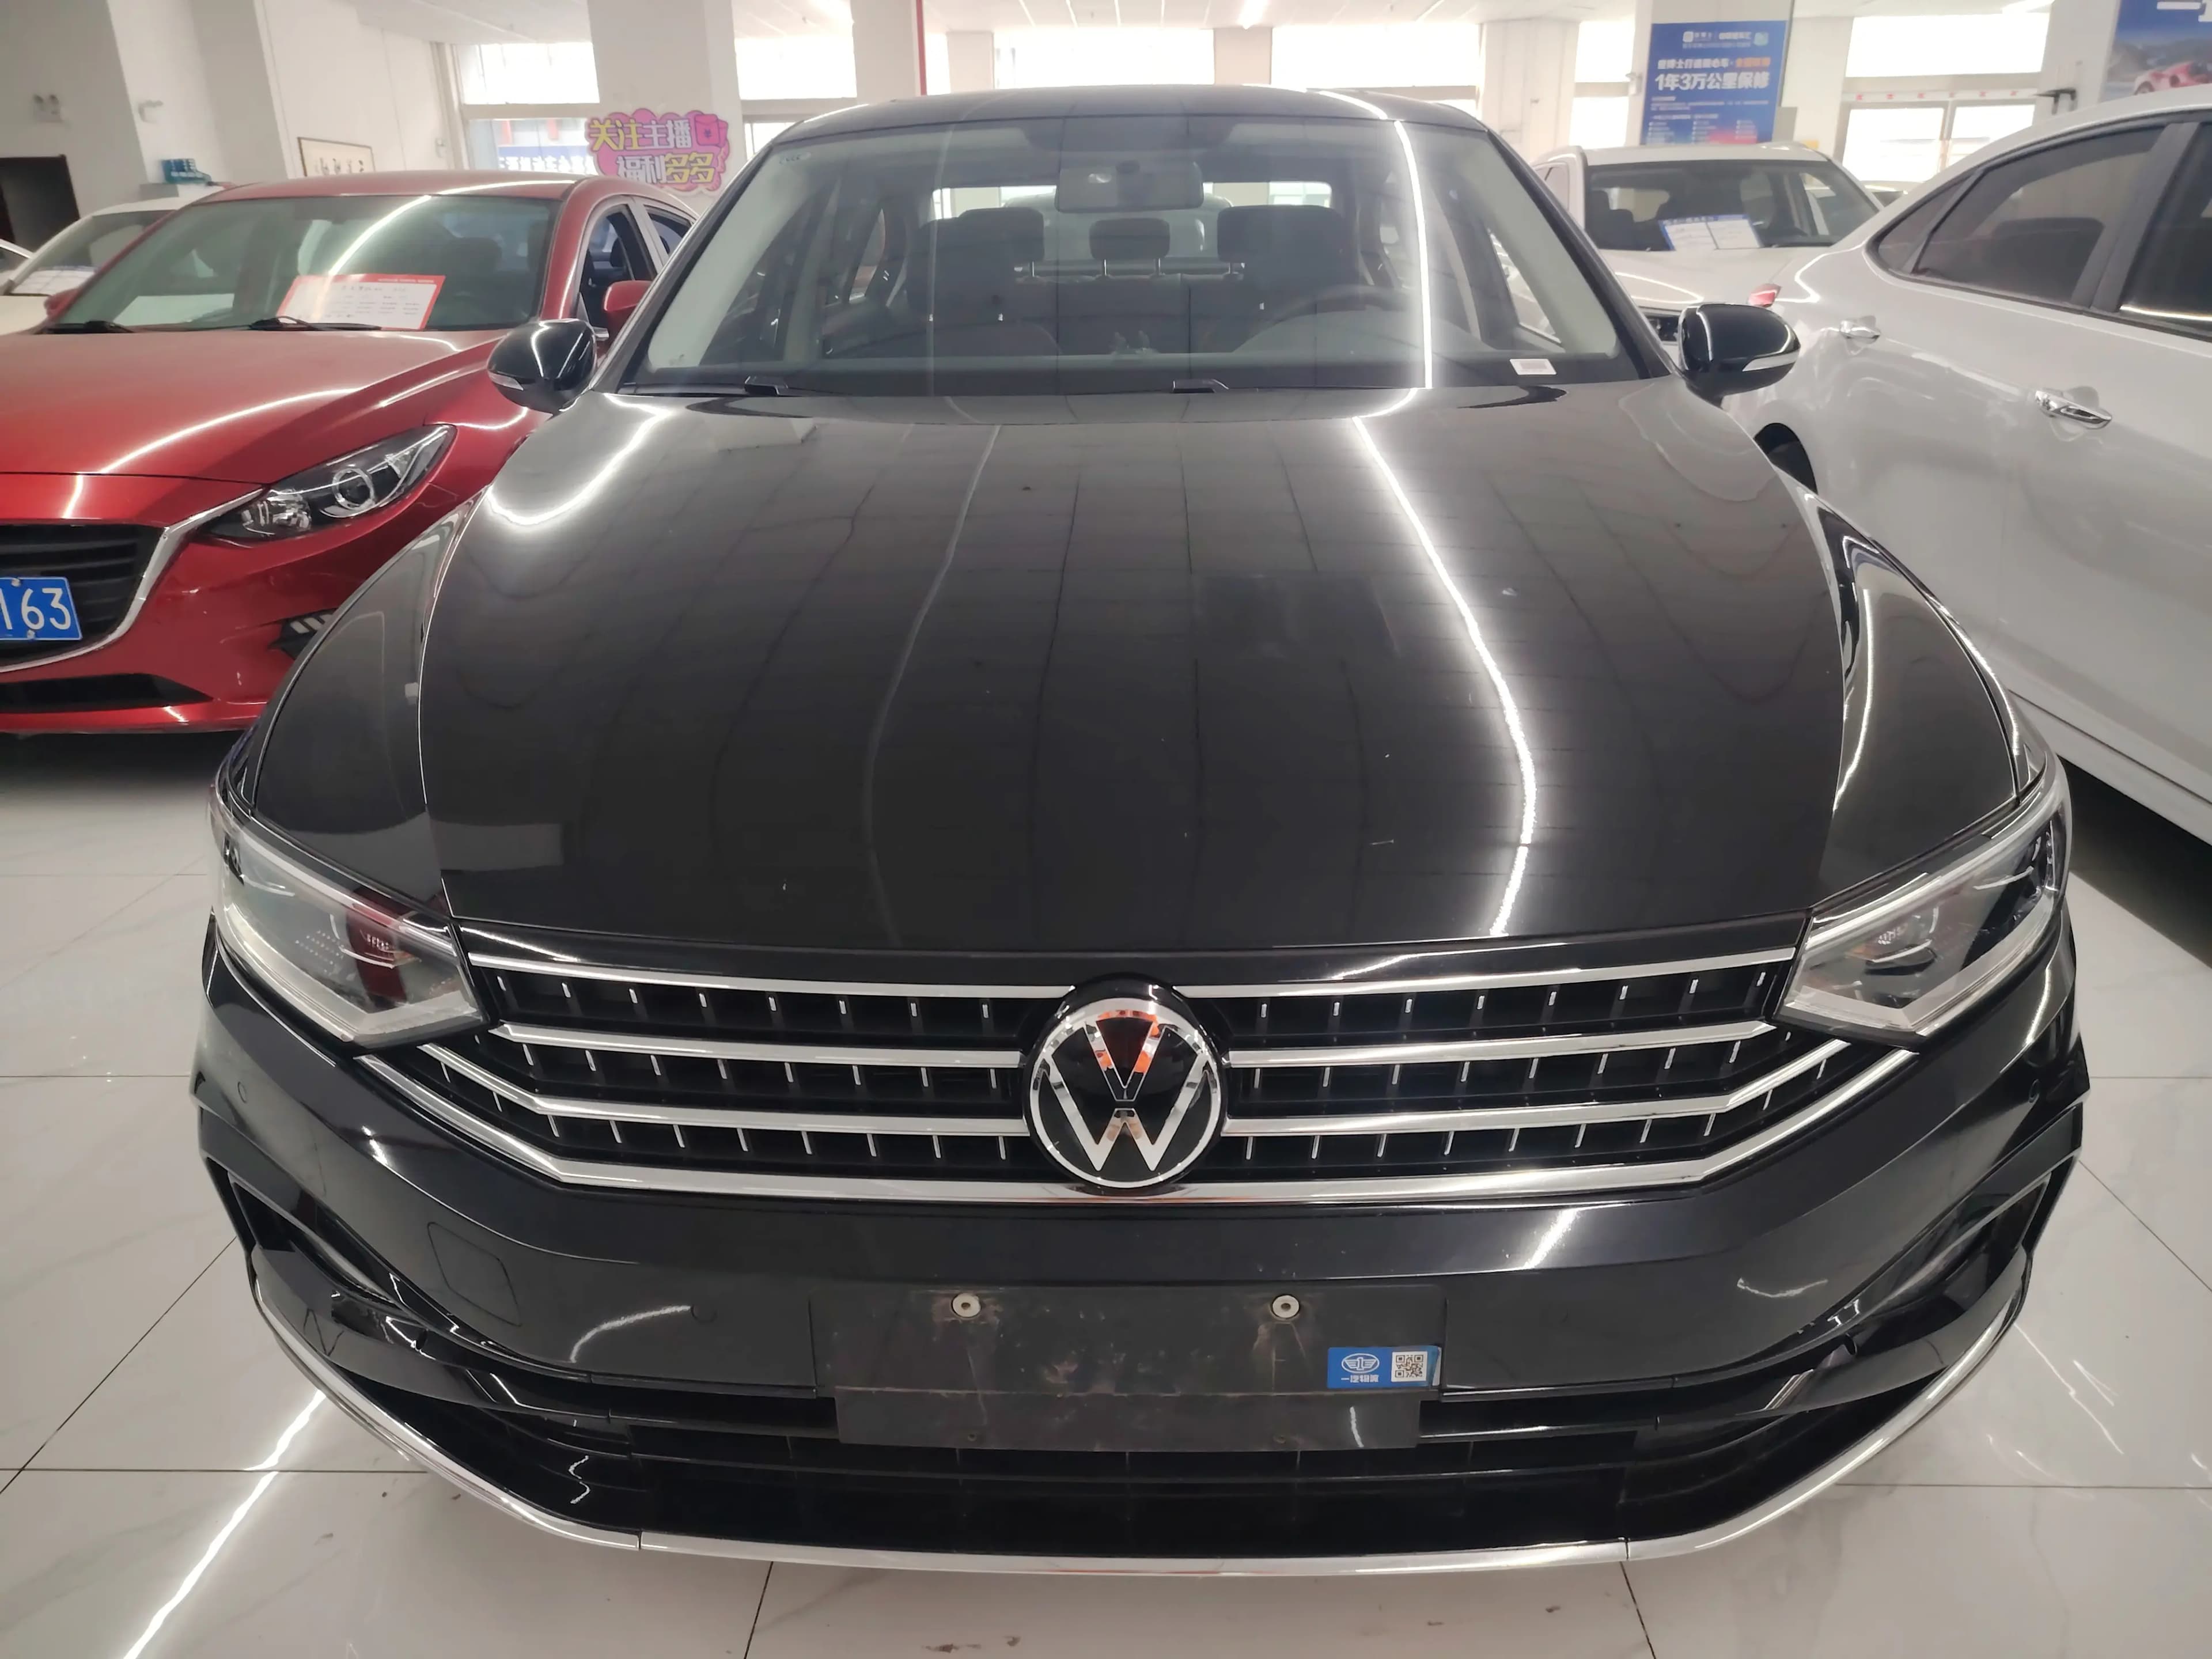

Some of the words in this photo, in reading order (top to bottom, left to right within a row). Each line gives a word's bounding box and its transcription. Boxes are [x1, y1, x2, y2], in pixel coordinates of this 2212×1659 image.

[589, 119, 691, 151] 关注主播
[616, 152, 715, 184] 福利多多
